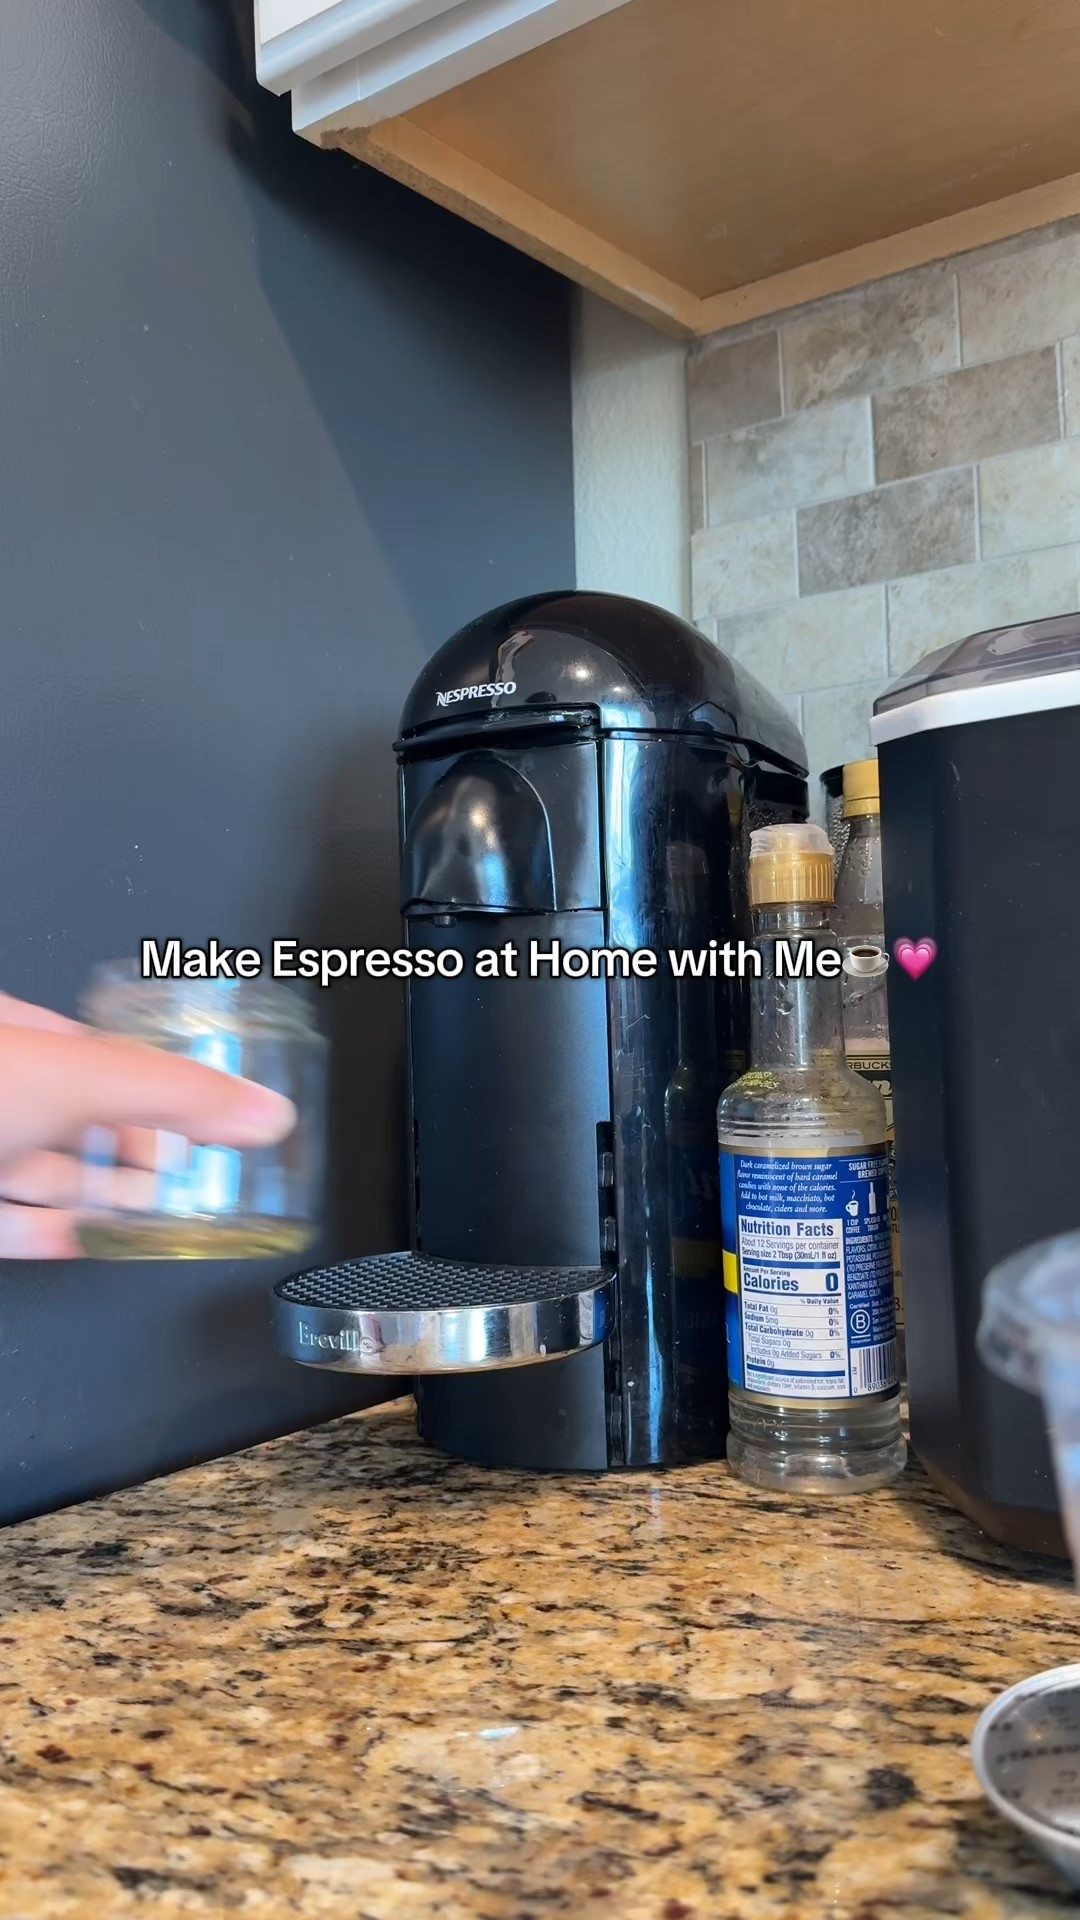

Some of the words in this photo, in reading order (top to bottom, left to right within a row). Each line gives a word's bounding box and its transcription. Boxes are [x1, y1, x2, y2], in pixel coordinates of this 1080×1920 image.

[435, 681, 517, 707] NESPRESSO
[740, 1160, 753, 1169] Dark
[753, 1161, 790, 1170] caramelized
[790, 1161, 813, 1170] brown
[813, 1163, 832, 1172] sugar
[848, 1162, 867, 1171] SUGAR
[752, 1170, 786, 1180] reminiscent
[786, 1171, 795, 1182] of
[795, 1171, 811, 1181] hard
[811, 1171, 838, 1180] caramel
[758, 1182, 772, 1191] with
[772, 1184, 788, 1192] none
[788, 1183, 797, 1193] of
[797, 1183, 809, 1191] the
[809, 1183, 836, 1191] calories.
[740, 1190, 751, 1199] Add
[751, 1192, 757, 1200] to
[758, 1193, 768, 1201] hot
[769, 1194, 785, 1203] milk,
[786, 1194, 823, 1203] macchiato,
[823, 1193, 835, 1202] hot
[745, 1203, 774, 1213] chocolate,
[774, 1203, 793, 1212] ciders
[794, 1204, 808, 1212] and
[808, 1205, 828, 1213] more.
[741, 1218, 795, 1236] Nutrition
[796, 1222, 834, 1236] Facts
[741, 1238, 757, 1248] About
[757, 1239, 765, 1248] 12
[765, 1240, 795, 1252] Servings
[795, 1242, 804, 1251] per
[804, 1240, 839, 1250] container
[742, 1246, 760, 1258] Serving
[760, 1249, 772, 1258] size
[772, 1250, 777, 1258] 2
[777, 1250, 793, 1260] Tbsp
[827, 1251, 837, 1260] oz)
[769, 1268, 791, 1277] Serving
[743, 1272, 800, 1292] Calories
[825, 1272, 839, 1292] 0
[806, 1297, 822, 1305] Daily
[822, 1297, 839, 1305] Value
[744, 1301, 757, 1311] Total
[757, 1303, 769, 1312] Fat
[769, 1304, 778, 1315] 0g
[828, 1307, 840, 1316] 0%
[744, 1312, 765, 1323] Sodium
[765, 1315, 779, 1325] 5mg
[828, 1319, 840, 1327] 0%
[855, 1313, 866, 1329] B
[744, 1322, 759, 1333] Total
[759, 1326, 804, 1338] Carbohydrate
[804, 1329, 815, 1339] 0g
[828, 1329, 841, 1337] 0%
[748, 1333, 762, 1344] Total
[761, 1335, 782, 1347] Sugars
[782, 1338, 791, 1348] 0g
[750, 1345, 771, 1357] Includes
[771, 1348, 780, 1358] 0g
[780, 1348, 800, 1358] Added
[800, 1350, 823, 1360] Sugars
[829, 1350, 842, 1359] 0%
[746, 1354, 766, 1366] Protein
[766, 1357, 775, 1368] 0g
